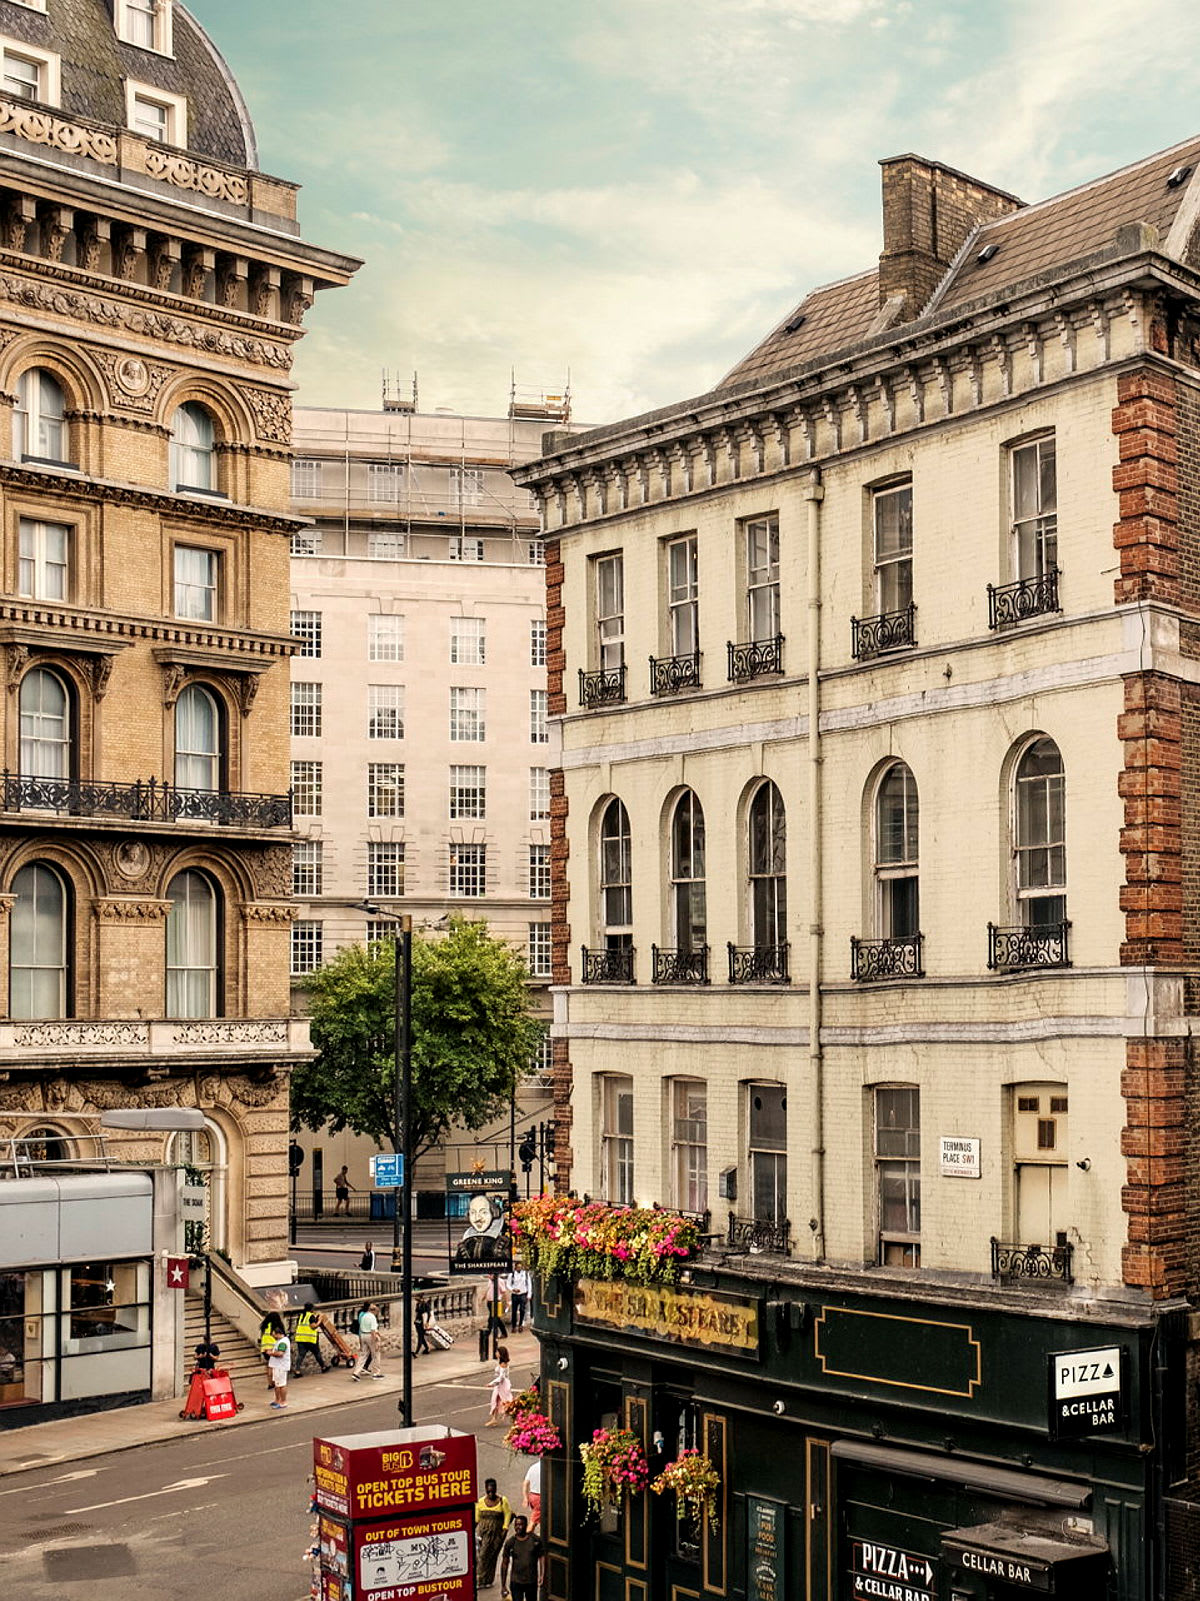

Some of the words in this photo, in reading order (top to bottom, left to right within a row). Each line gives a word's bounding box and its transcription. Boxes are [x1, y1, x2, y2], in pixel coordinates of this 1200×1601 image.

[943, 1141, 972, 1152] TERMINUS
[943, 1153, 960, 1163] PLACE
[962, 1154, 975, 1164] SW1
[1092, 1412, 1114, 1425] BAR
[382, 1452, 399, 1463] BIG
[357, 1480, 388, 1494] OPEN
[391, 1477, 413, 1490] TOP
[416, 1474, 438, 1487] BUS
[441, 1470, 470, 1482] TOUR
[357, 1487, 424, 1509] TICKETS
[429, 1481, 471, 1500] HERE
[366, 1530, 385, 1541] OUT
[387, 1528, 399, 1538] OF
[401, 1524, 429, 1536] TOWN
[431, 1520, 462, 1532] TOURS
[862, 1542, 908, 1580] PIZZA
[962, 1552, 1004, 1576] CELLAR
[1008, 1562, 1031, 1583] BAR
[368, 1590, 394, 1601] OPEN
[397, 1587, 415, 1597] TOP
[855, 1576, 863, 1591] &
[864, 1579, 903, 1601] CELLAR
